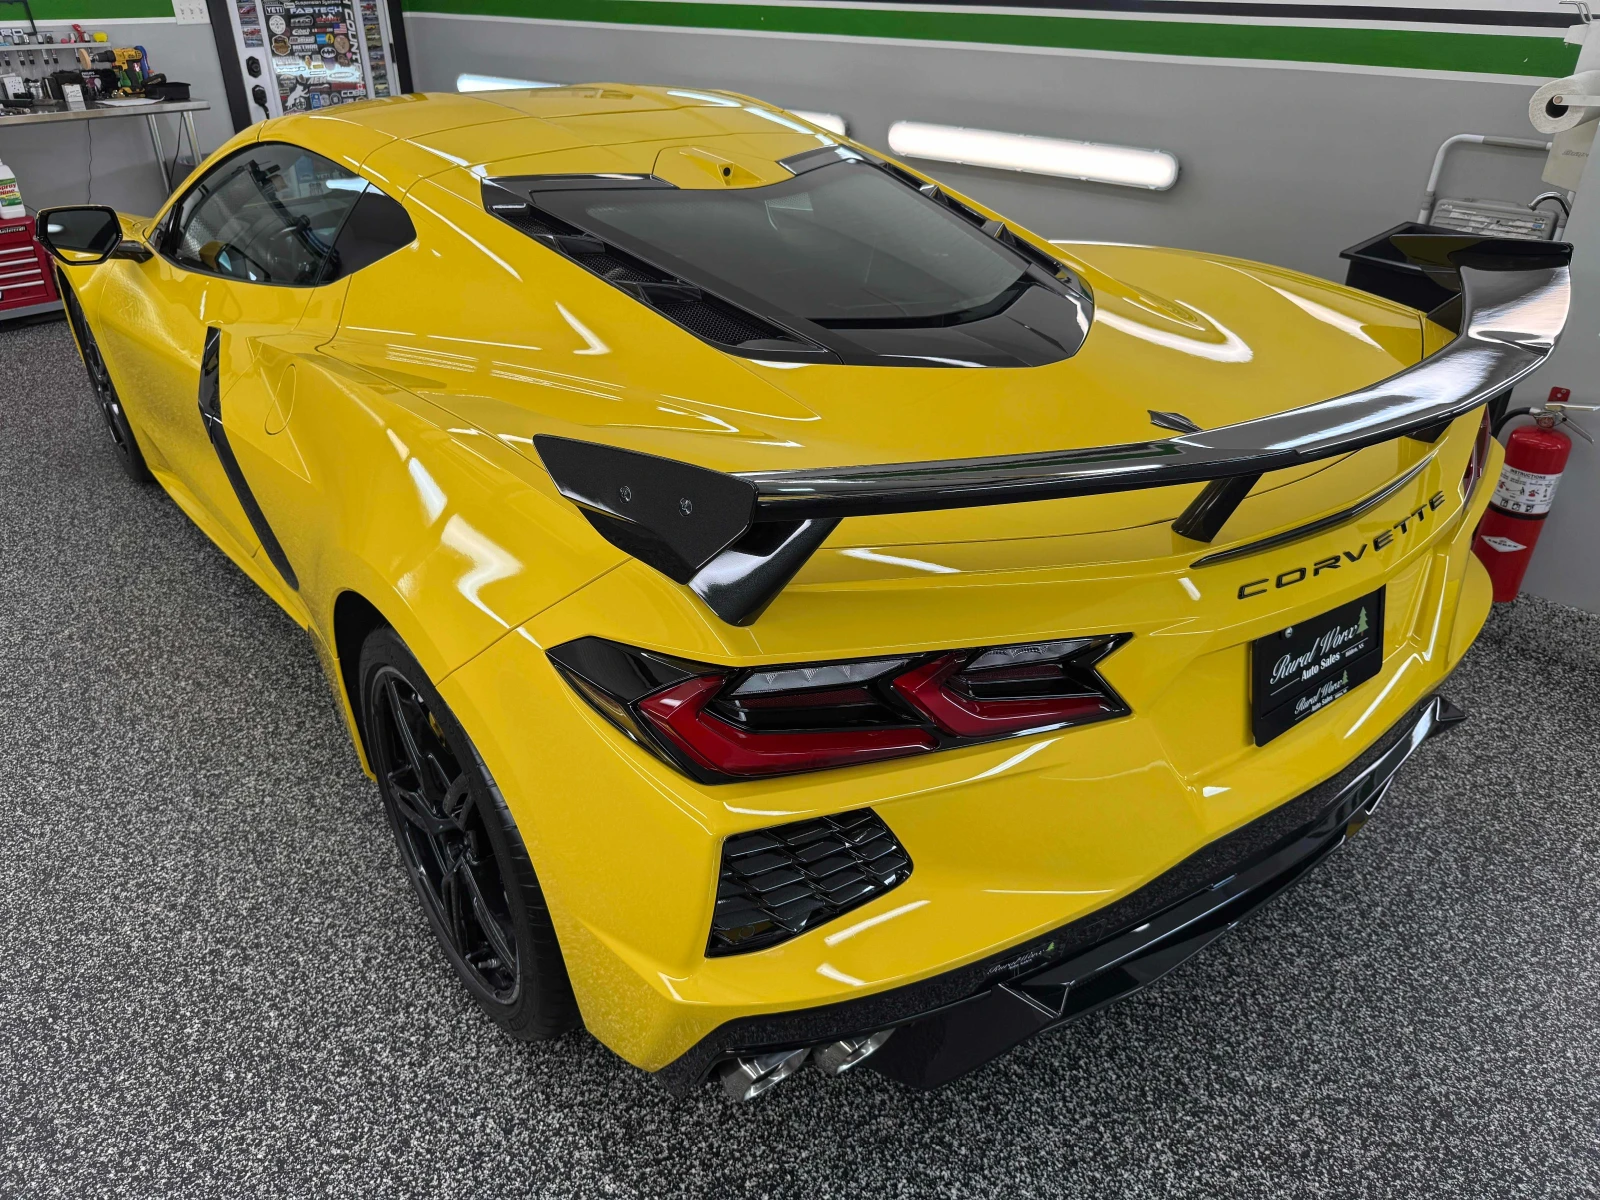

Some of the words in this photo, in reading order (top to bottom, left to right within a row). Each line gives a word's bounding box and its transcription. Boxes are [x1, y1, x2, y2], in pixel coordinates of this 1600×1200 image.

[290, 6, 342, 14] FABTECH
[341, 89, 366, 97] COBB
[1510, 468, 1547, 480] INSTRUCTIONS
[1237, 490, 1445, 600] CORVETTE
[1270, 637, 1320, 684] Rural
[1301, 664, 1320, 681] Auto
[1320, 652, 1341, 670] Sales
[1294, 688, 1321, 715] Rural
